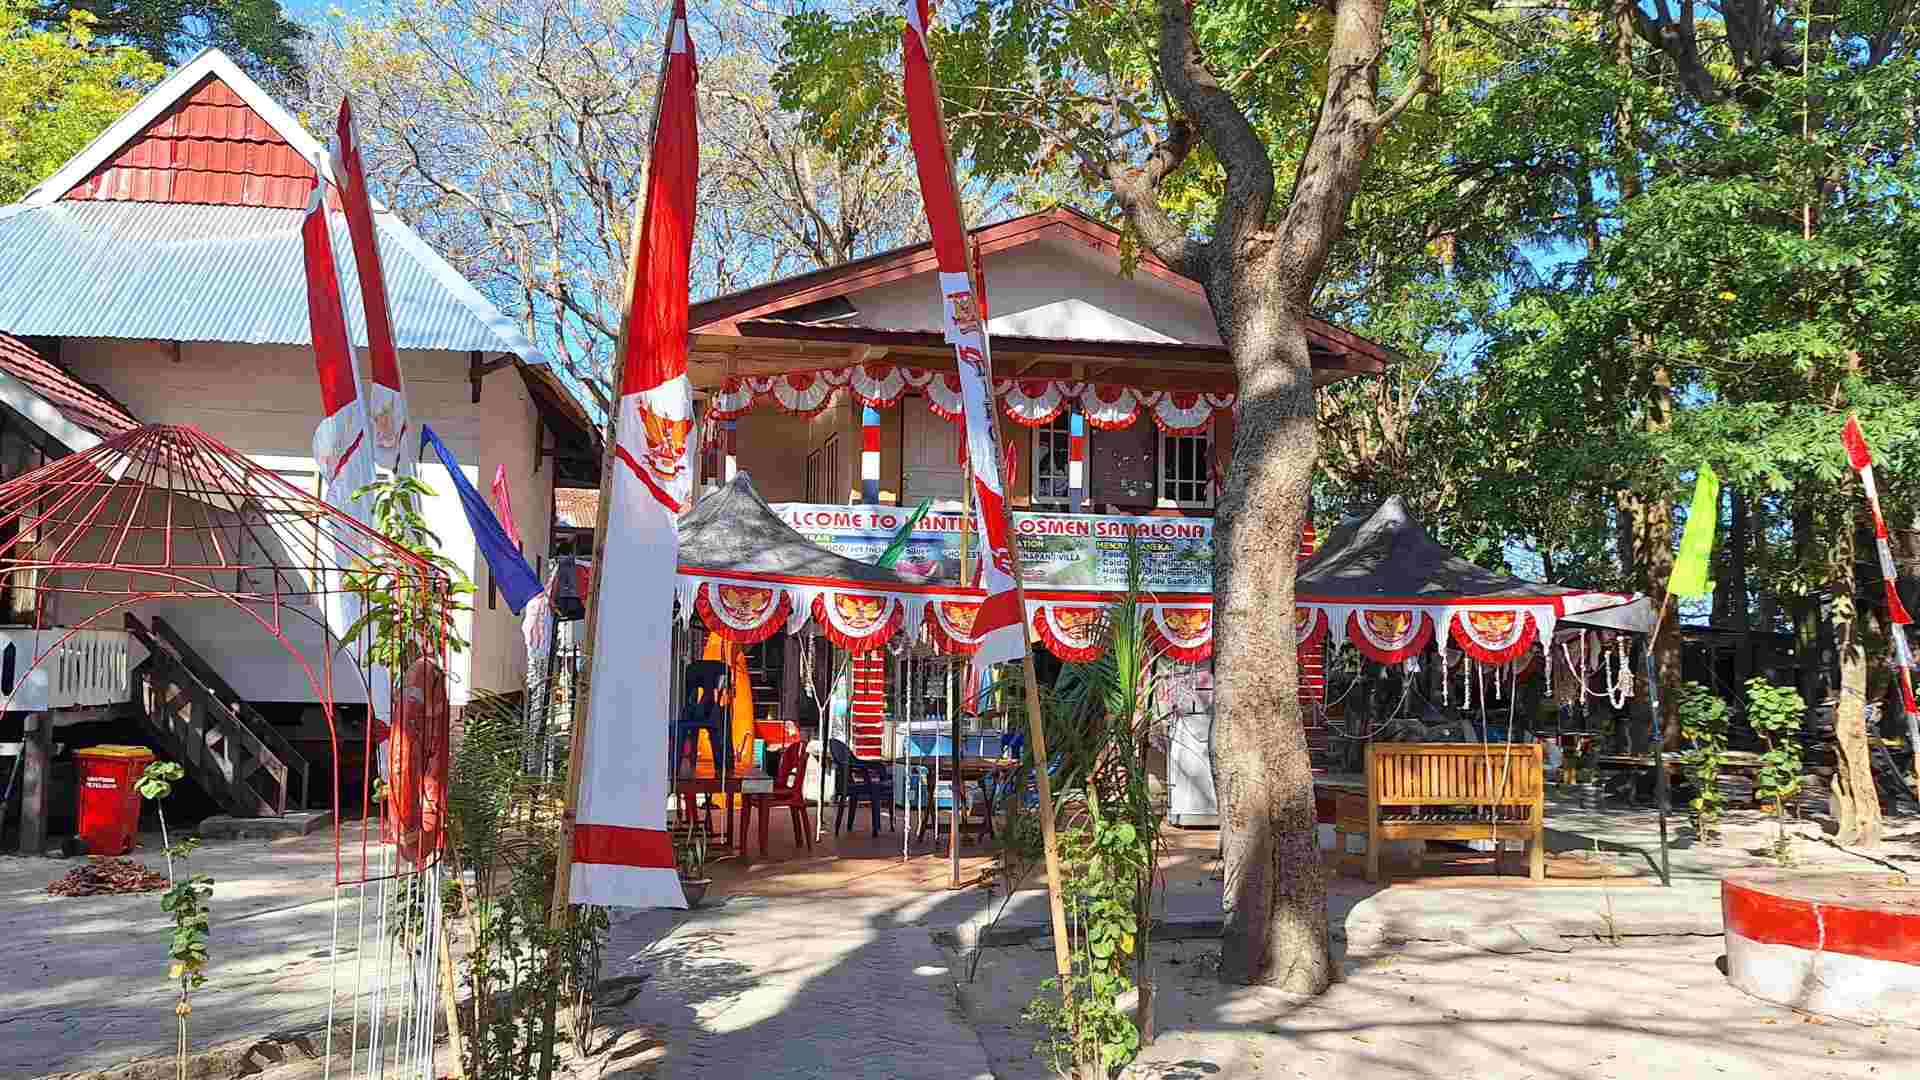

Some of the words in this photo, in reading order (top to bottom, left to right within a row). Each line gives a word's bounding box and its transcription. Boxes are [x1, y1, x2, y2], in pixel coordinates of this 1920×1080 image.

[870, 512, 897, 528] TO
[1014, 519, 1090, 535] OSMEN
[1095, 522, 1205, 538] SAMALONA
